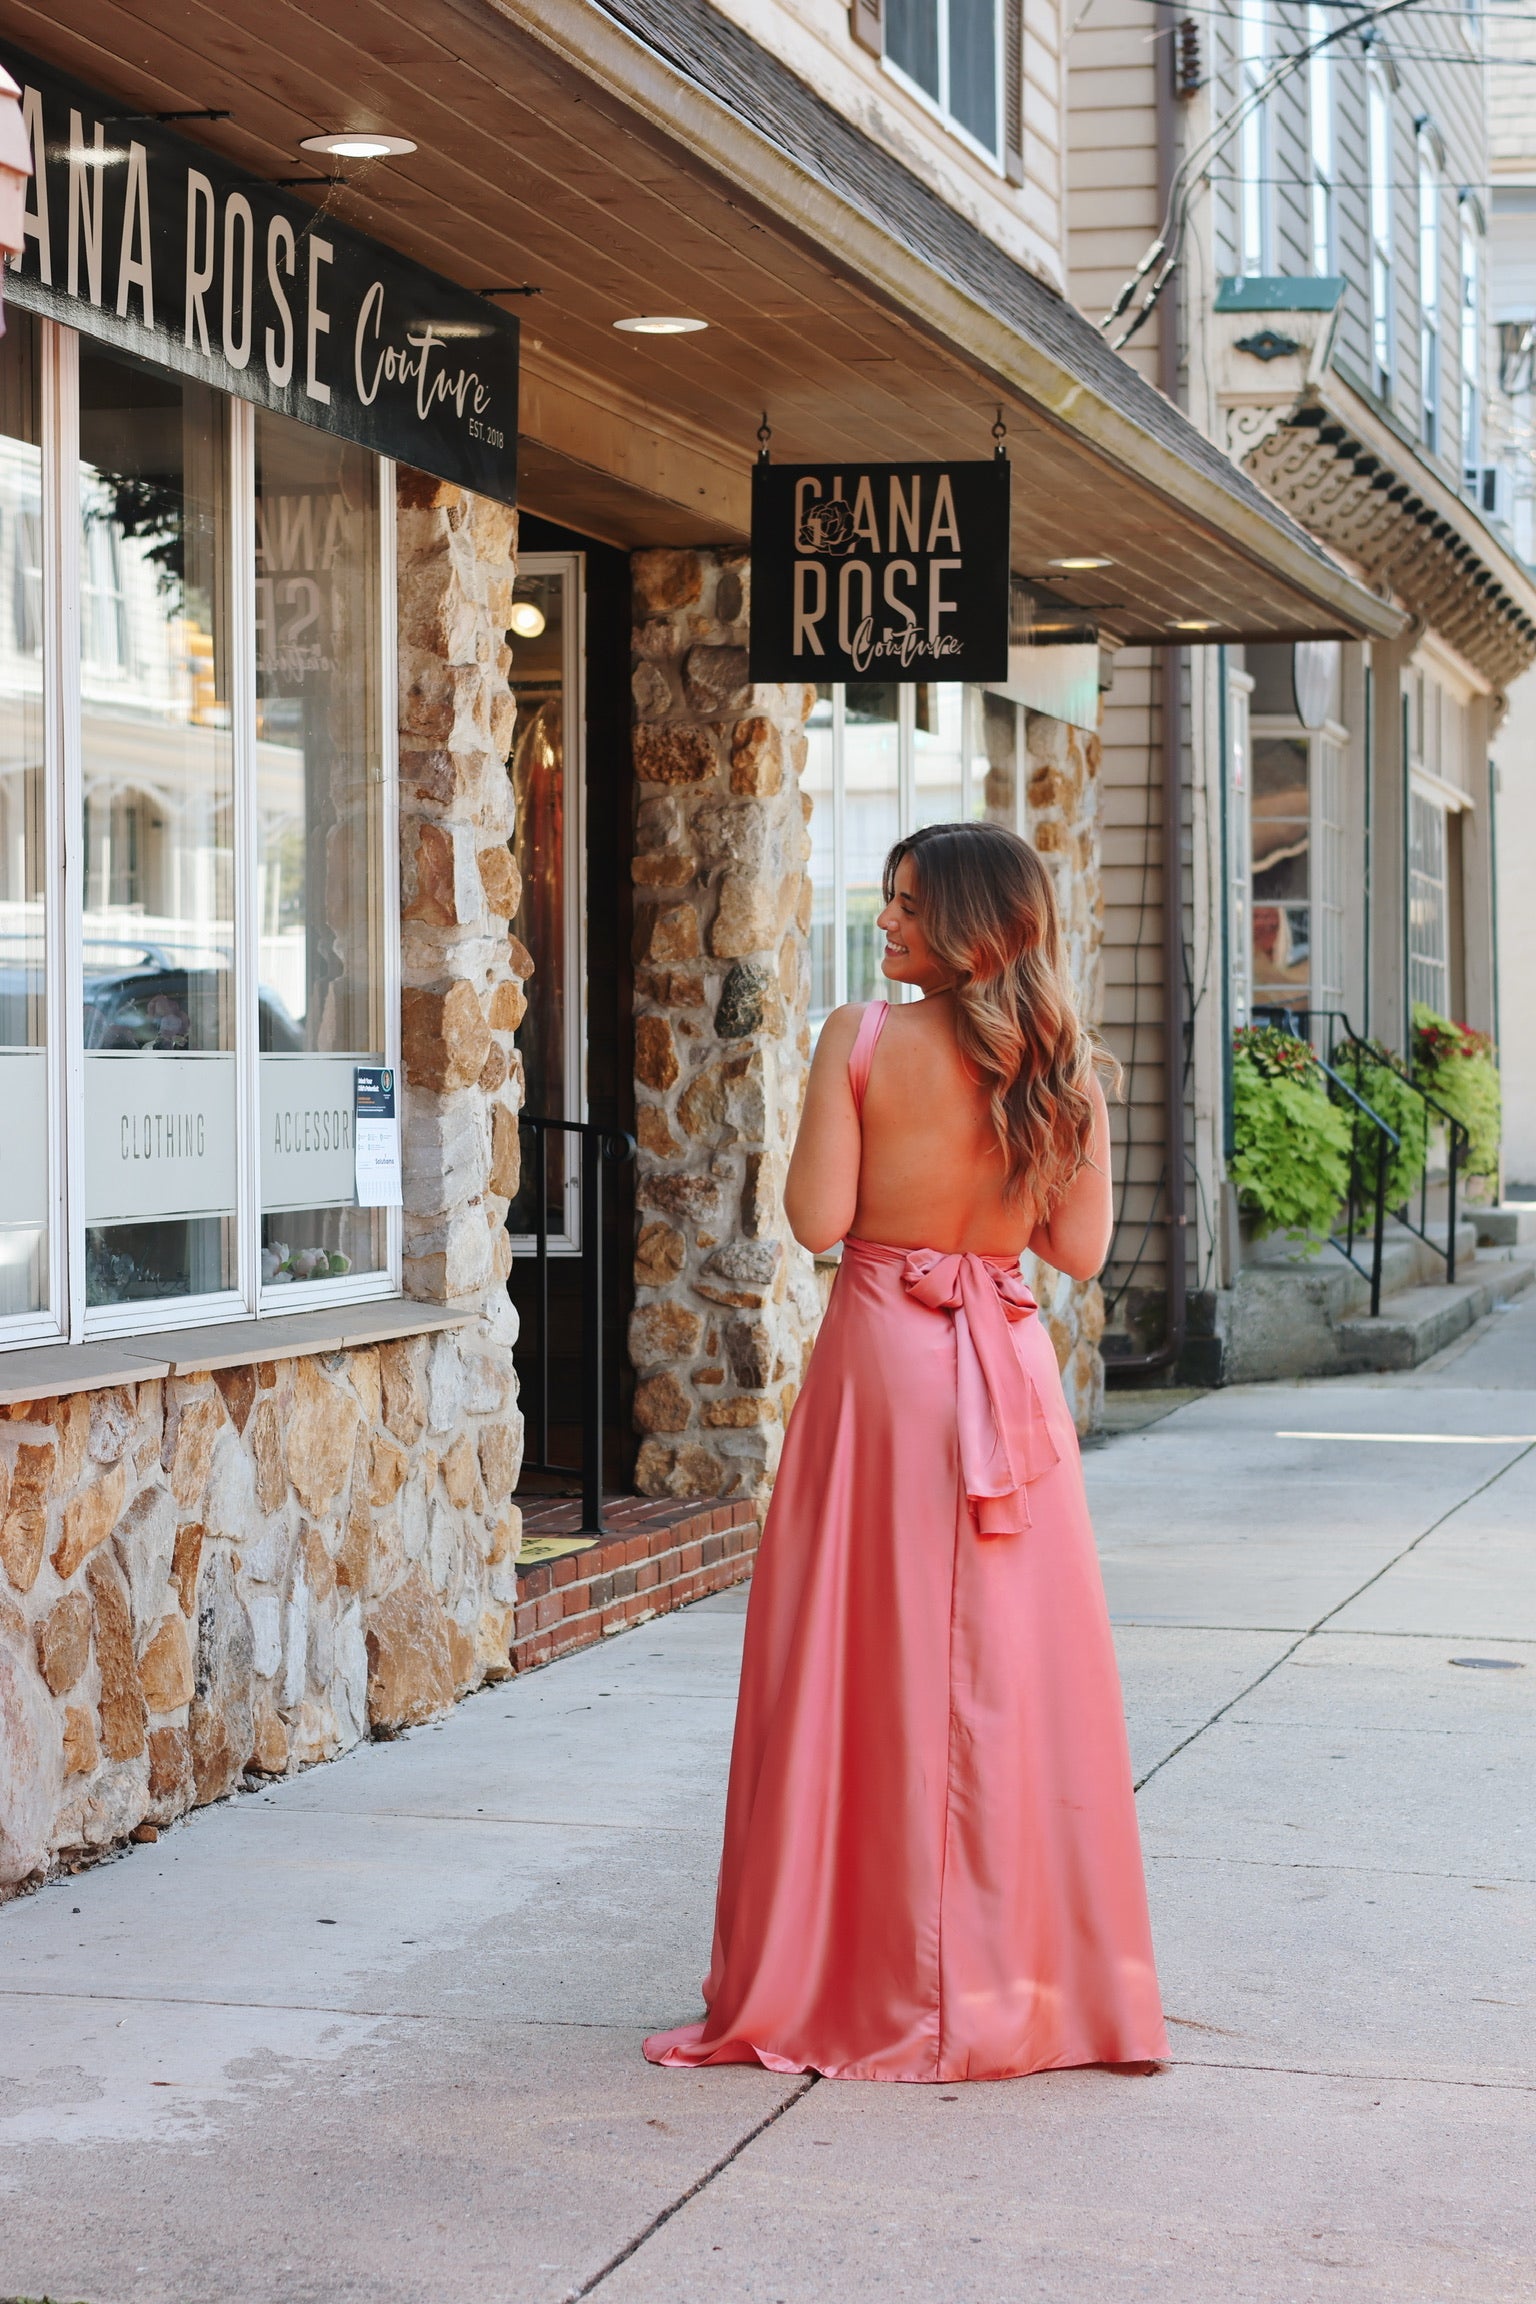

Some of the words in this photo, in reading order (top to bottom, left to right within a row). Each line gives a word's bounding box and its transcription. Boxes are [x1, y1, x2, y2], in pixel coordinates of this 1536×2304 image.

[185, 168, 334, 406] ROSE
[355, 281, 491, 421] Couture
[469, 418, 485, 441] EST.
[487, 427, 504, 449] 2018
[793, 559, 962, 656] ROSE
[852, 616, 964, 673] Couture
[120, 1113, 205, 1160] CLOTHING
